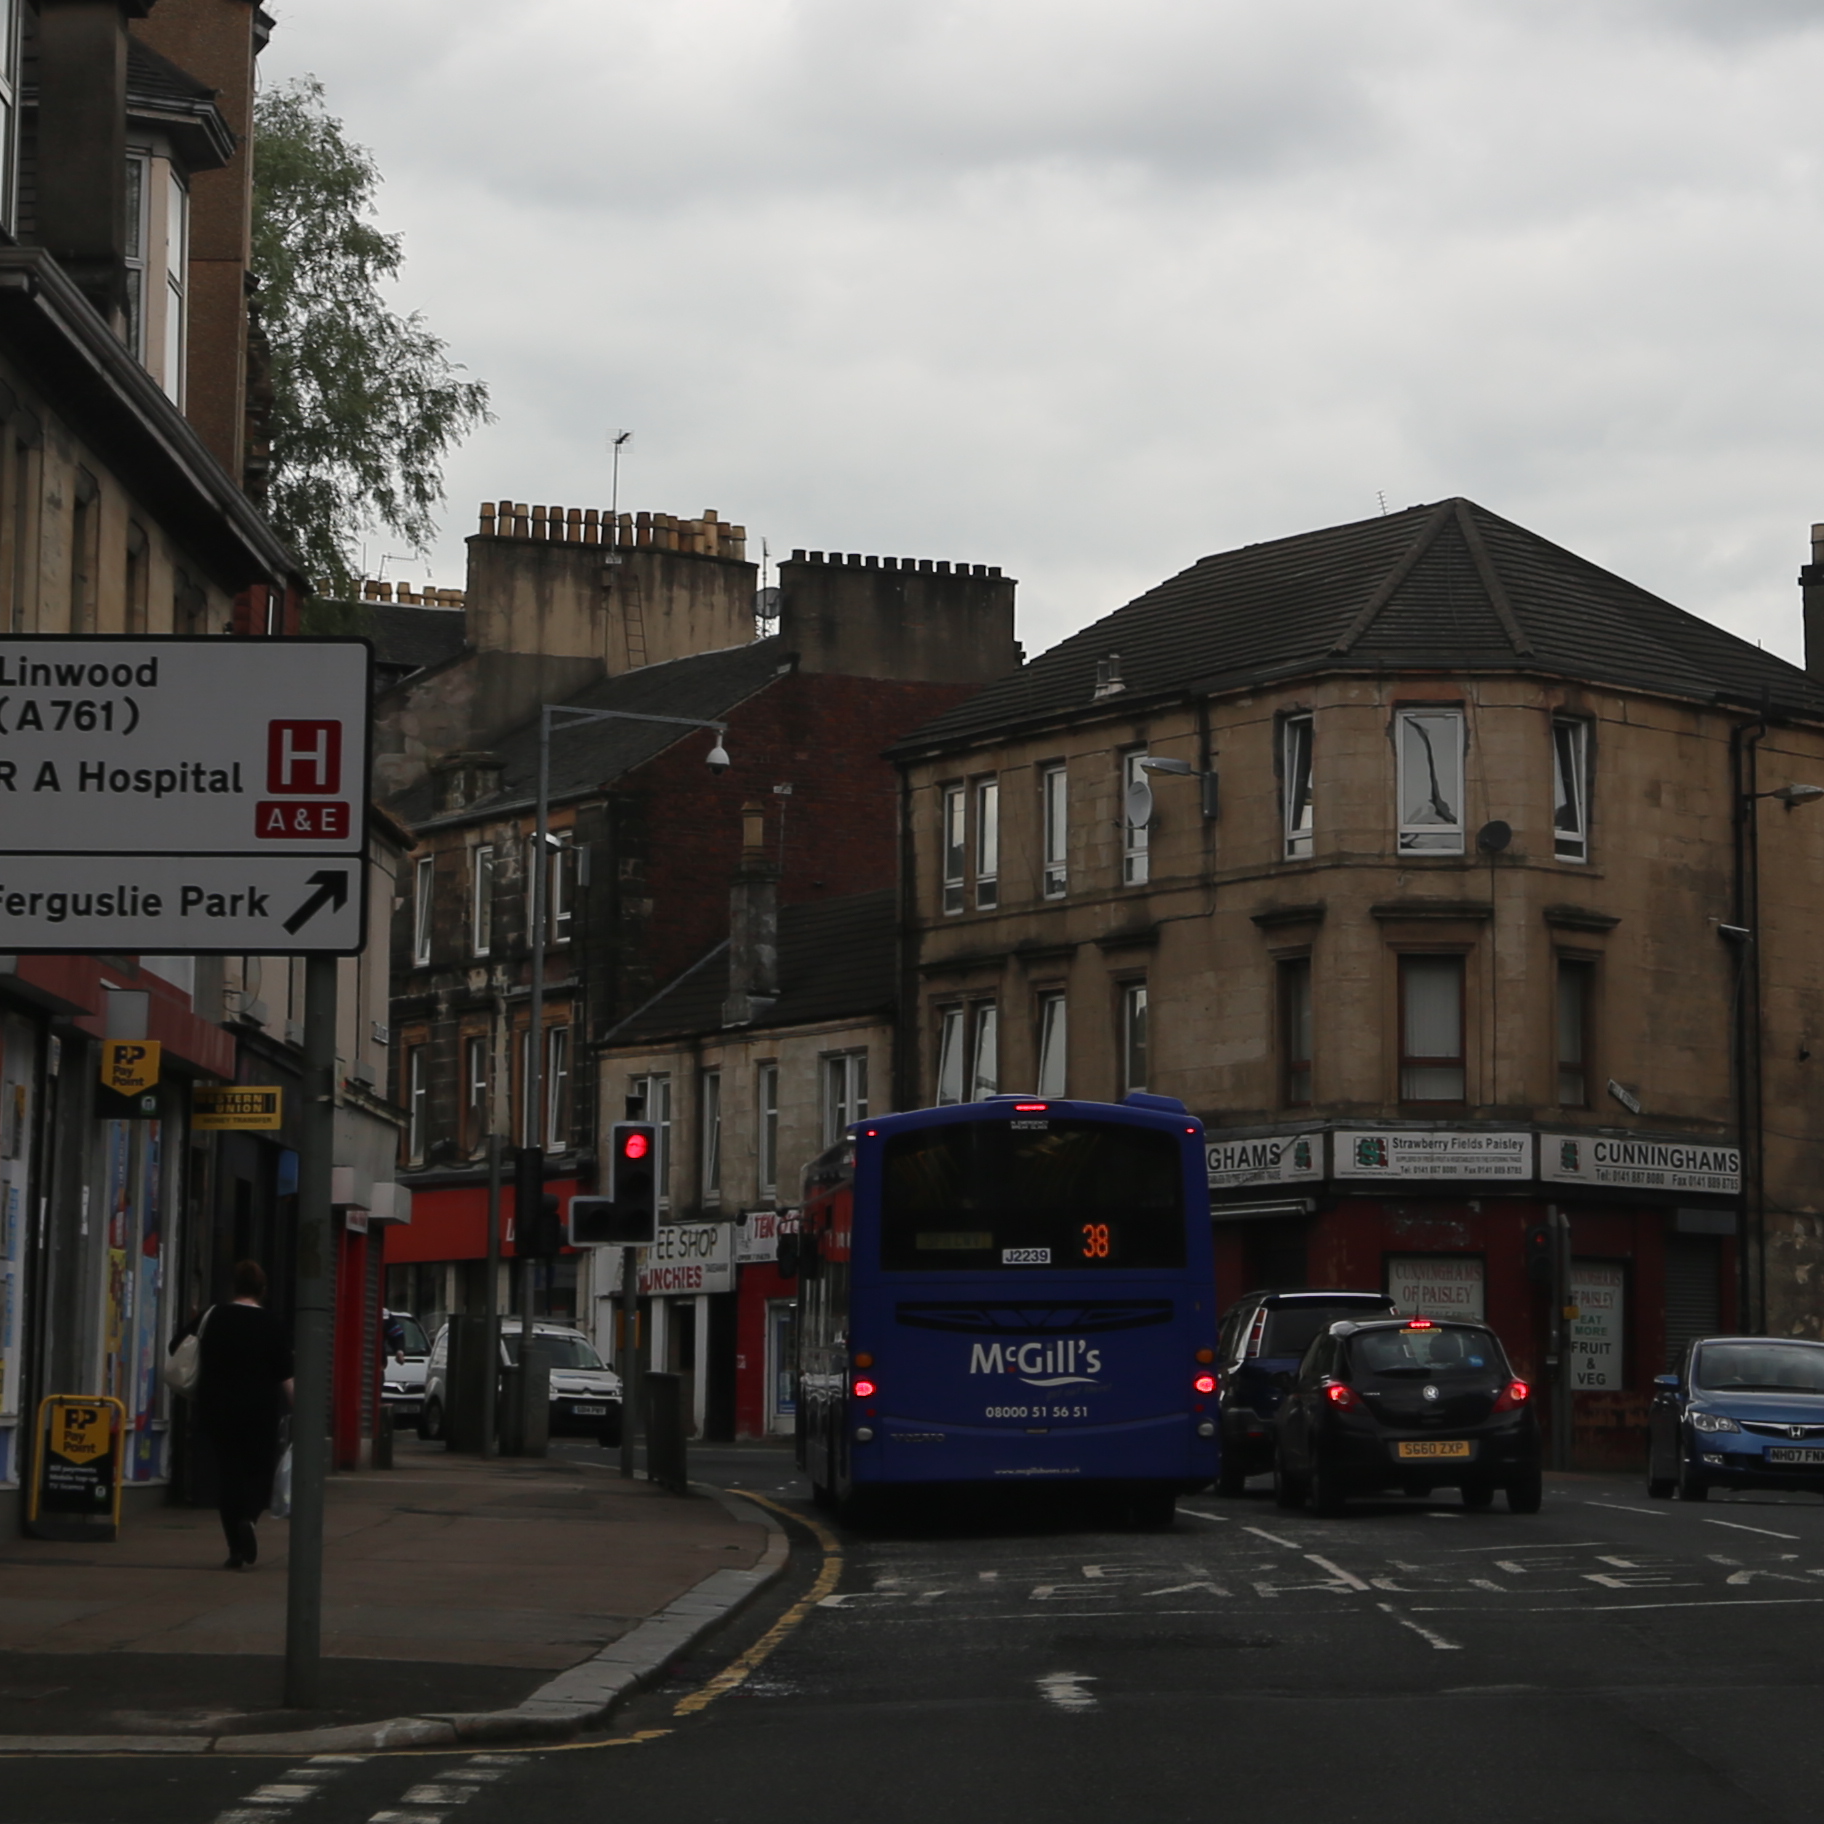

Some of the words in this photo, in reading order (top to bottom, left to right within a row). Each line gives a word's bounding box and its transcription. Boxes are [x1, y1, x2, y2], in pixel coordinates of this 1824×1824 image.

[281, 728, 328, 786] H
[34, 761, 60, 791] A
[79, 761, 243, 798] Hospital
[180, 885, 270, 917] Park
[113, 1066, 134, 1077] Pay
[112, 1077, 144, 1086] Point
[195, 1093, 263, 1104] WESTERN
[215, 1104, 263, 1113] UNION
[1392, 1137, 1448, 1151] Strawberry
[1451, 1137, 1483, 1149] Fields
[1486, 1138, 1524, 1152] Paisley
[1594, 1142, 1740, 1173] CUNNINGHAMS
[1612, 1169, 1630, 1182] 0141
[1672, 1174, 1687, 1187] Fax
[1688, 1175, 1706, 1188] 0141
[678, 1228, 717, 1258] SHOP
[1082, 1224, 1110, 1258] 38
[1005, 1250, 1048, 1262] J2239
[1395, 1264, 1483, 1280] CUNNINGHAMS
[1403, 1286, 1419, 1302] OF
[1422, 1284, 1473, 1304] PAISLEY
[1580, 1290, 1614, 1310] PAISLEY
[1580, 1314, 1602, 1325] EAT
[1575, 1326, 1607, 1337] MORE
[1571, 1342, 1611, 1355] FRUIT
[969, 1339, 1102, 1374] McGill's
[1586, 1357, 1596, 1370] &
[1578, 1373, 1606, 1385] VEG
[985, 1406, 1028, 1418] 08000
[1032, 1406, 1047, 1418] 51
[1052, 1406, 1069, 1418] 56
[1073, 1406, 1088, 1418] 51
[64, 1431, 85, 1444] Pay
[64, 1442, 96, 1453] Point
[1440, 1442, 1464, 1454] ZXP
[1772, 1449, 1802, 1462] NH07
